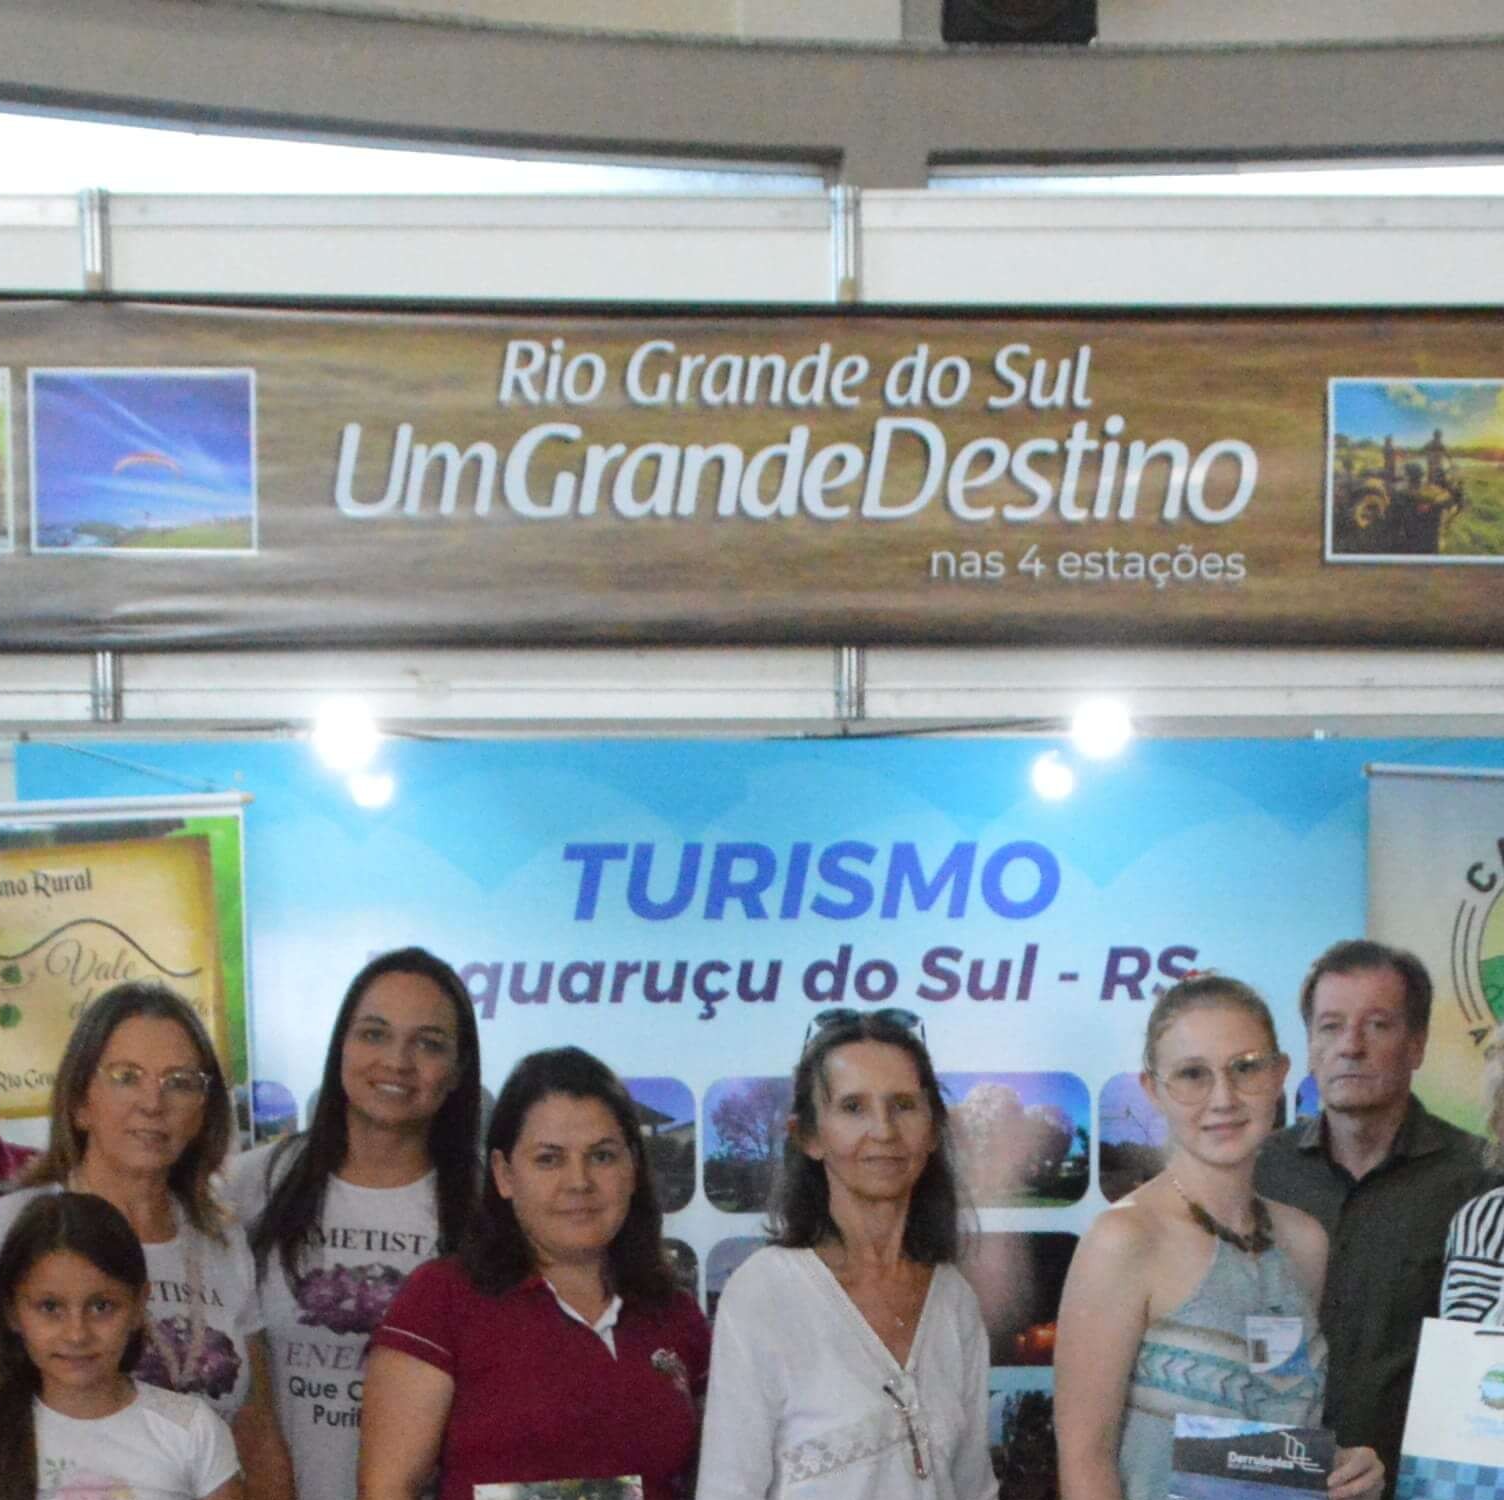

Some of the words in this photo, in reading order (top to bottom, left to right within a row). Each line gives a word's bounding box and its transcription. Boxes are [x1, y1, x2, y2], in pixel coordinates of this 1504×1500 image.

[498, 338, 607, 403] Rio
[626, 340, 869, 407] Grande
[884, 343, 971, 407] do
[989, 343, 1093, 408] Sul
[331, 415, 1260, 525] UmGrandeDestino
[931, 549, 1007, 579] nas
[1017, 543, 1047, 579] 4
[1057, 542, 1247, 590] estações
[30, 867, 94, 898] Rural
[561, 838, 1062, 923] TURISMO
[368, 948, 784, 1021] quaruçu
[802, 943, 899, 1002] do
[916, 943, 1040, 1002] Sul
[1058, 971, 1080, 983] -
[1100, 945, 1201, 1001] RS
[288, 1375, 338, 1399] Que
